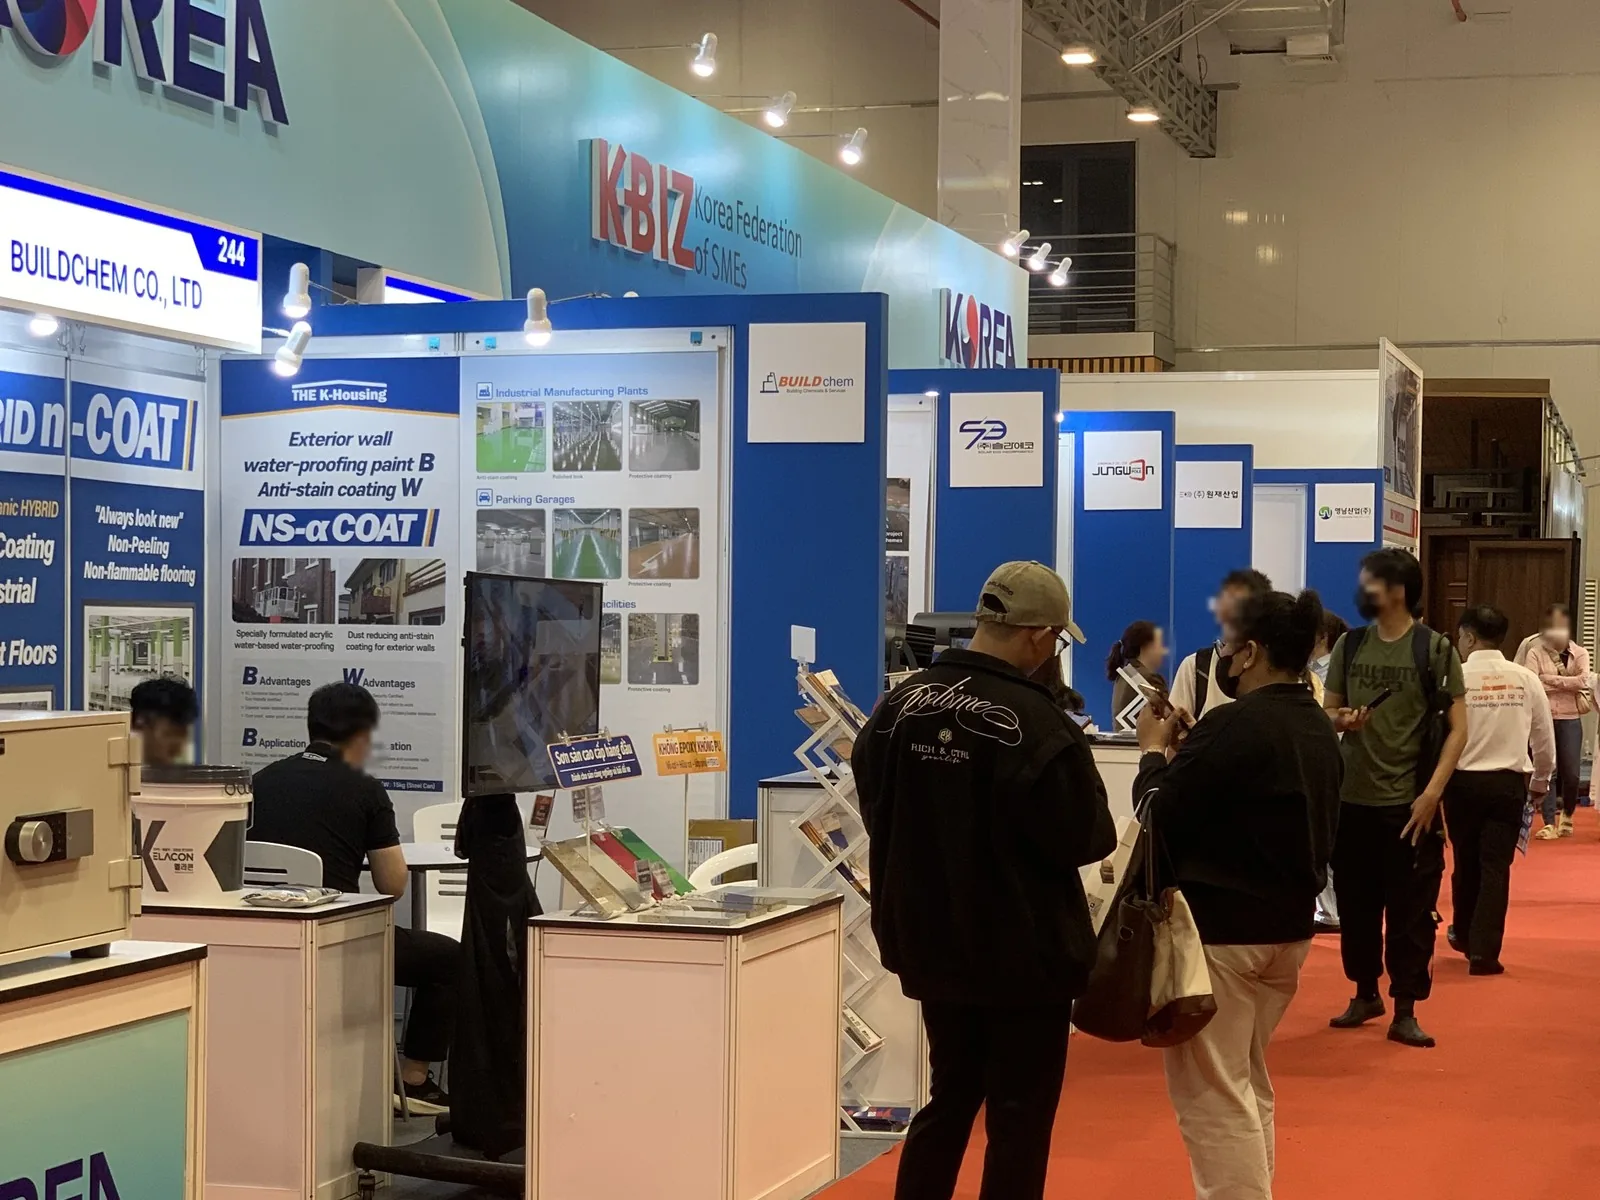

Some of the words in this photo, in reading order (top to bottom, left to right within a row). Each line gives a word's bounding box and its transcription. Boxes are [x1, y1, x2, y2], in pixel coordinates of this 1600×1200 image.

[694, 183, 733, 233] Korea
[736, 200, 802, 258] Federation
[217, 236, 246, 267] 244
[694, 237, 710, 274] of
[712, 244, 747, 289] SMEs
[11, 240, 128, 295] BUILDCHEM
[133, 269, 168, 309] CO.,
[172, 276, 203, 309] LTD
[292, 389, 316, 401] THE
[319, 388, 387, 403] K-Housing
[495, 388, 541, 398] Industrial
[544, 387, 614, 398] Manufacturing
[617, 386, 648, 396] Plants
[289, 431, 353, 447] Exterior
[357, 430, 393, 447] wall
[244, 456, 367, 476] water-proofing
[370, 456, 414, 476] paint
[419, 452, 435, 472] B
[257, 481, 333, 497] Anti-stain
[338, 482, 397, 501] coating
[401, 478, 423, 497] W
[496, 494, 533, 506] Parking
[535, 494, 575, 505] Garages
[20, 499, 59, 518] HYBRID
[135, 508, 157, 528] look
[108, 534, 169, 559] Non-Peeling
[84, 561, 159, 583] Non-flammable
[160, 564, 196, 587] flooring
[236, 630, 267, 640] Specially
[269, 630, 308, 639] formulated
[309, 631, 333, 640] acrylic
[348, 631, 364, 639] Dust
[366, 631, 398, 641] reducing
[400, 632, 434, 640] anti-stain
[8, 639, 57, 666] Floors
[234, 642, 279, 650] water-based
[281, 642, 335, 653] water-proofing
[345, 643, 373, 653] coating
[374, 643, 385, 652] for
[386, 644, 414, 652] exterior
[416, 644, 435, 652] walls
[243, 667, 258, 685] B
[260, 677, 311, 688] Advantages
[342, 668, 365, 685] W
[362, 678, 416, 689] Advantages
[242, 728, 258, 746] B
[259, 738, 306, 749] Application
